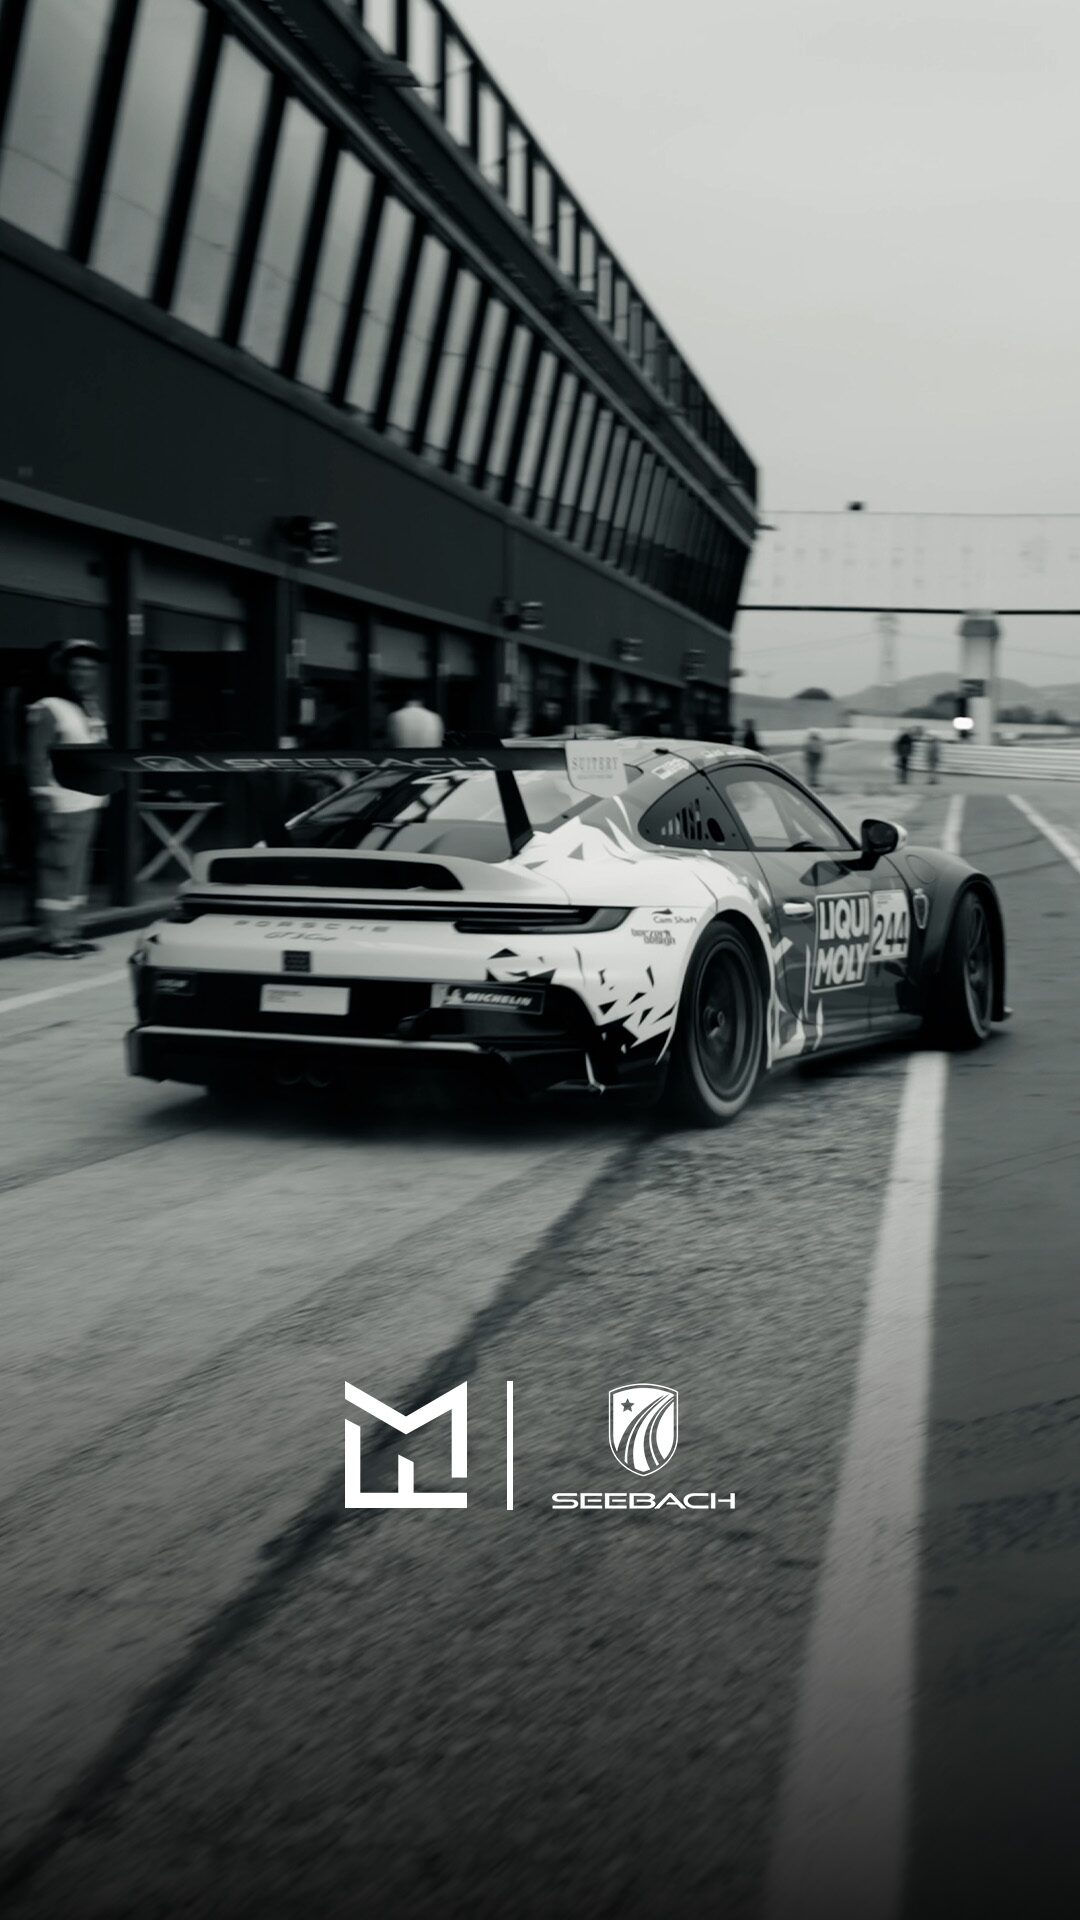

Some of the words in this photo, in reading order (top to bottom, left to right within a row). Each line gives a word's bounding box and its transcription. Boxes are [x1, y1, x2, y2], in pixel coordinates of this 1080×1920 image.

[223, 756, 495, 769] SEEBACH
[234, 919, 389, 933] PORSCHE
[819, 898, 870, 941] LIQUI
[872, 911, 907, 956] 244
[814, 942, 870, 987] MOLY
[463, 991, 533, 1007] MICHELIN
